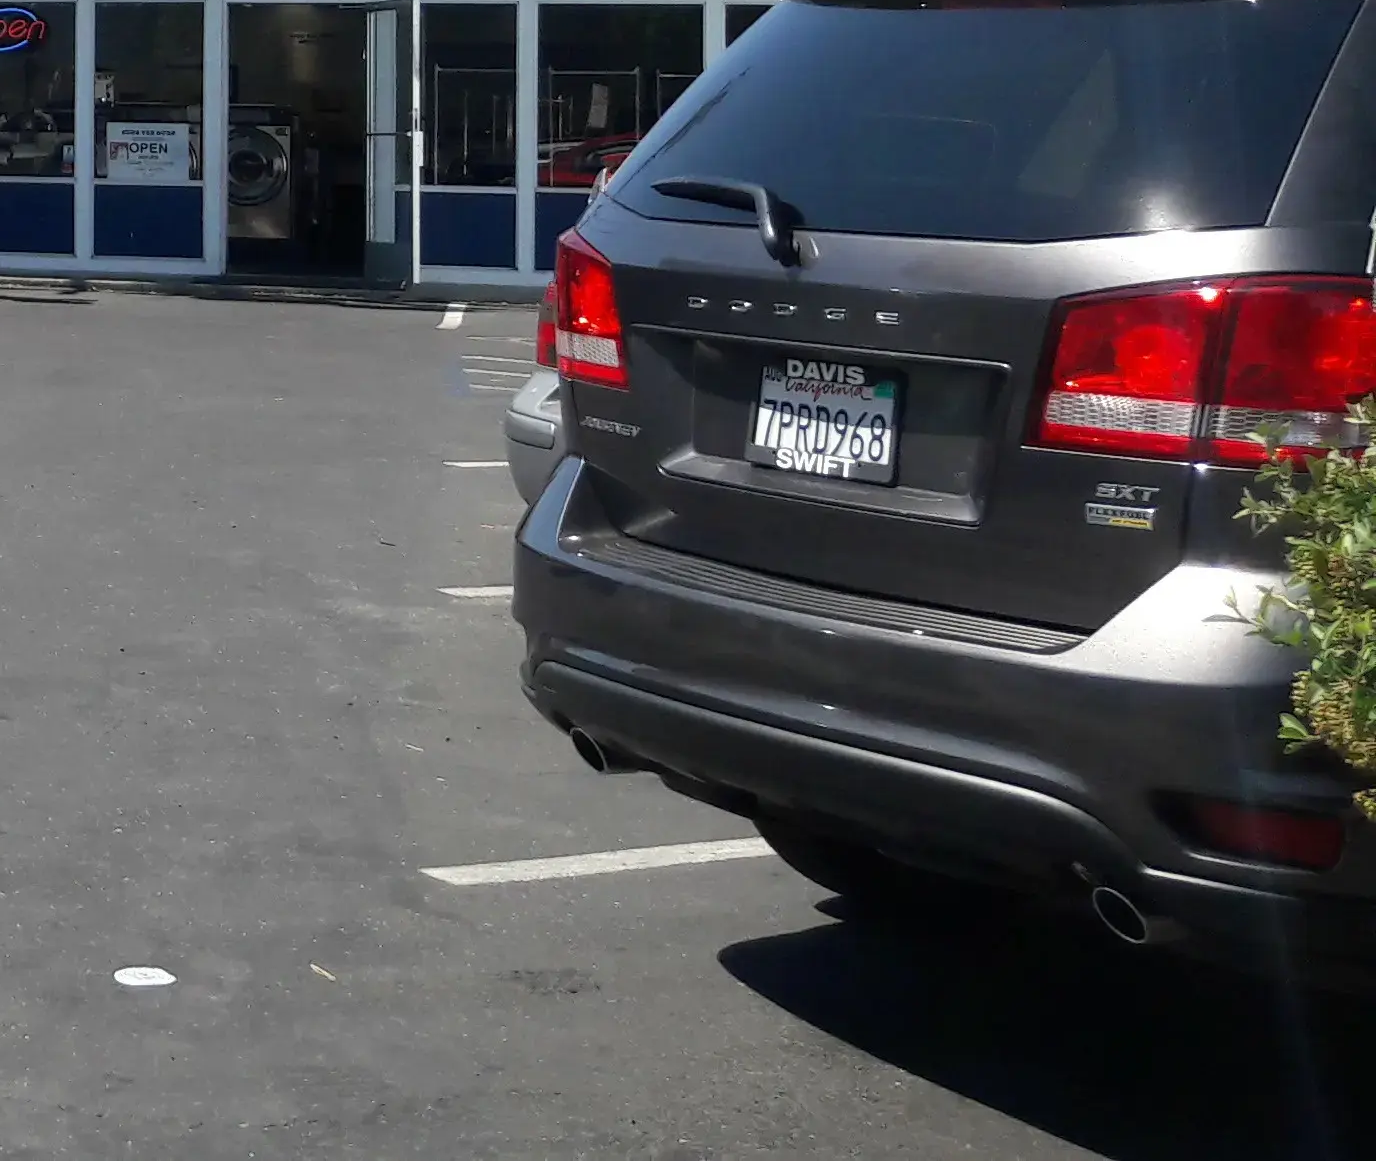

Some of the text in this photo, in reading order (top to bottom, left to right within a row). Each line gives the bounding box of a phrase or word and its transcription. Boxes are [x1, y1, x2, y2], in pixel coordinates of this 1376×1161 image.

[129, 142, 168, 154] OPEN
[687, 296, 900, 325] DODGE
[785, 358, 866, 385] DAVIS
[762, 397, 886, 462] 7PRD968
[775, 447, 855, 478] SWIFT
[1095, 482, 1160, 502] SXT
